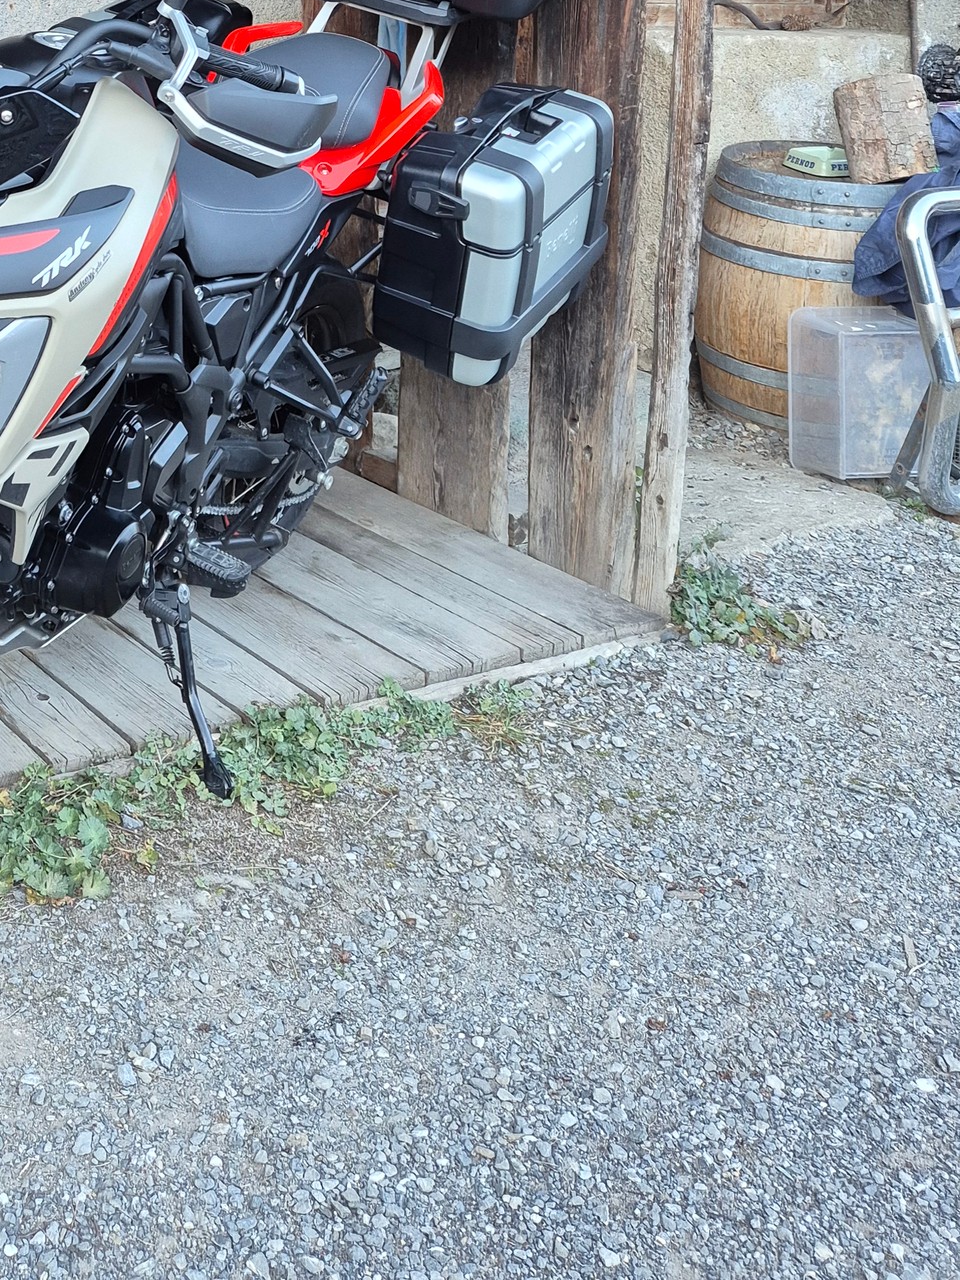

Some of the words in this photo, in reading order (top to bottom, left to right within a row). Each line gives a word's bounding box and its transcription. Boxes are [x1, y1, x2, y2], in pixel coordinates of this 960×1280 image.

[786, 154, 816, 169] PERNOD
[830, 163, 849, 172] PER
[31, 224, 92, 288] TRK
